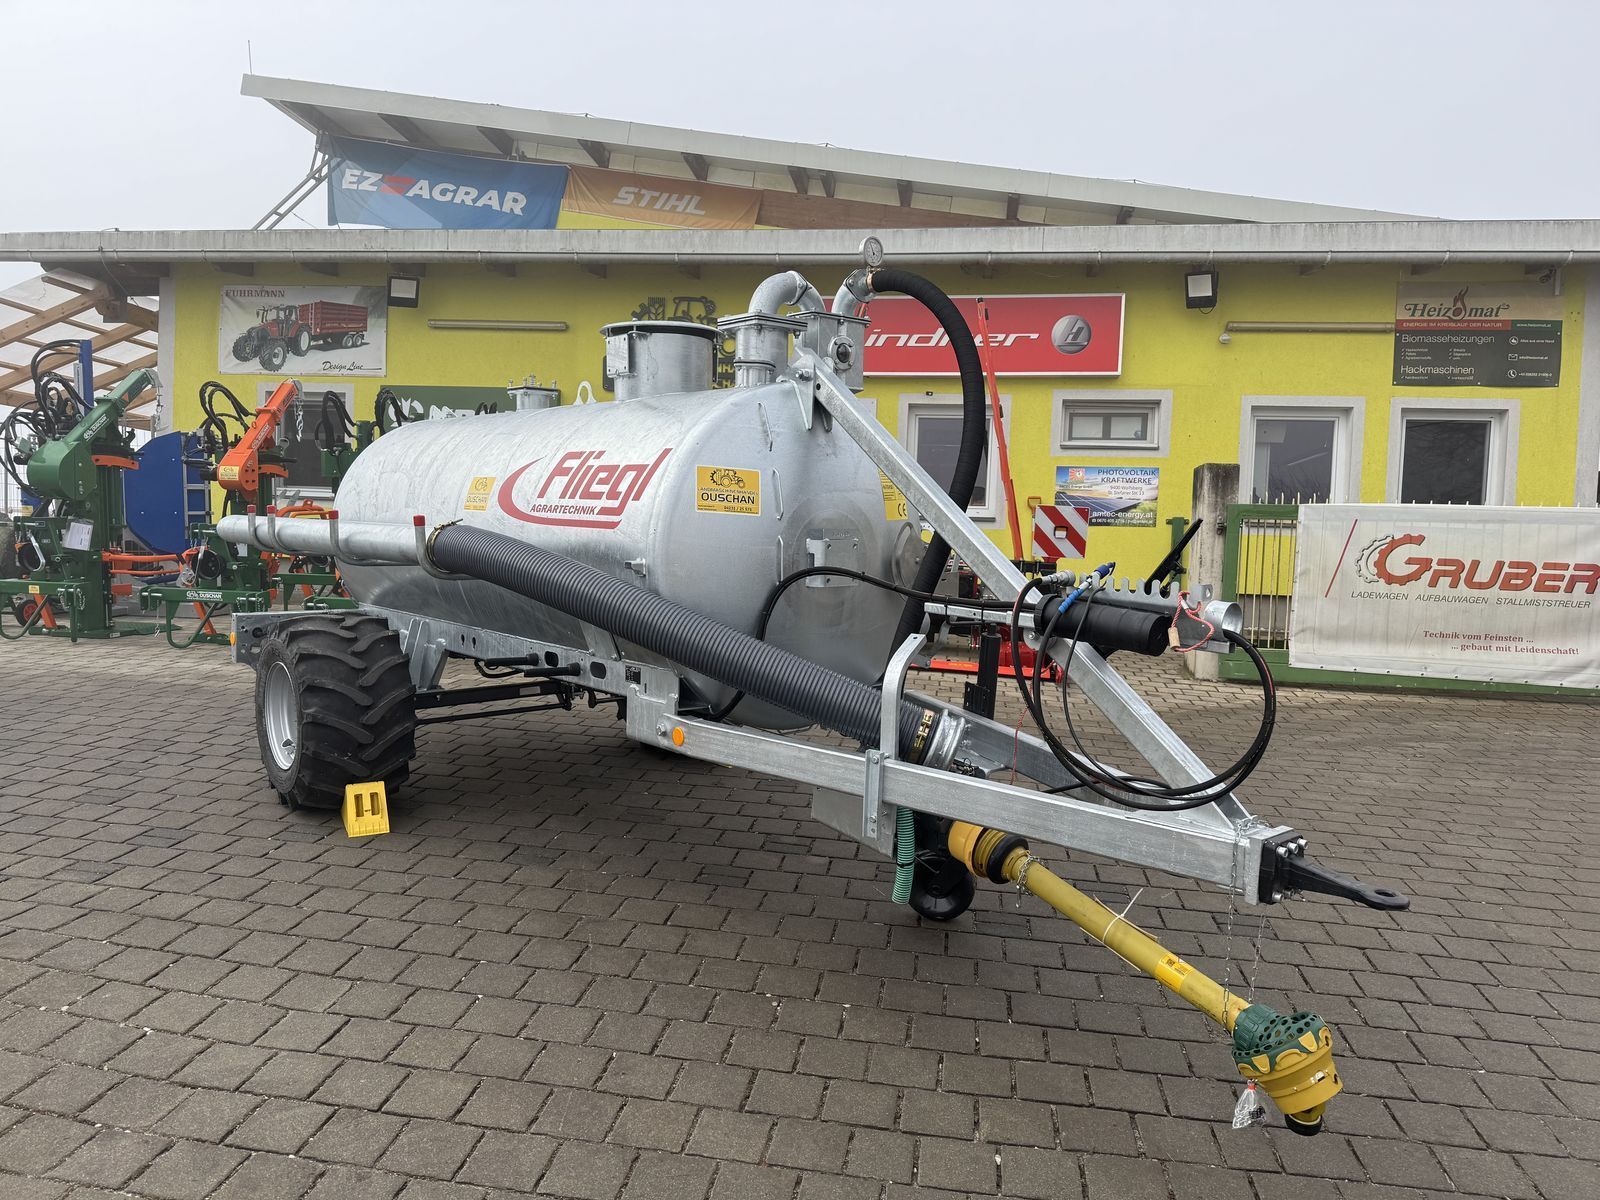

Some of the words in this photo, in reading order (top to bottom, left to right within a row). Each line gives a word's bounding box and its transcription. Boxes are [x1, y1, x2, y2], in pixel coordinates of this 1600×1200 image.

[341, 168, 379, 192] EZ
[402, 177, 528, 216] AGRAR
[611, 185, 707, 217] STIHL
[224, 288, 286, 298] FUHRMANN
[864, 327, 1040, 347] inder
[1401, 334, 1496, 345] Biomasseheizungen
[322, 360, 347, 372] Design
[347, 361, 364, 371] Line
[1400, 365, 1475, 375] Hackmaschinen
[537, 448, 674, 516] Fliegl
[701, 492, 755, 505] OUSCHAN
[529, 503, 598, 516] AGRARTECHNIK
[1374, 533, 1600, 594] GRUBER
[1351, 591, 1409, 601] LADEWAGEN
[1415, 593, 1488, 605] AUFBAUWAGEN
[1495, 597, 1591, 609] STALLMISTSTREUER
[1423, 630, 1460, 640] Technik
[1484, 633, 1523, 643] Feinsten
[1460, 643, 1492, 652] gebaut
[1495, 644, 1512, 653] mit
[1514, 645, 1580, 655] Leidenschaft!
